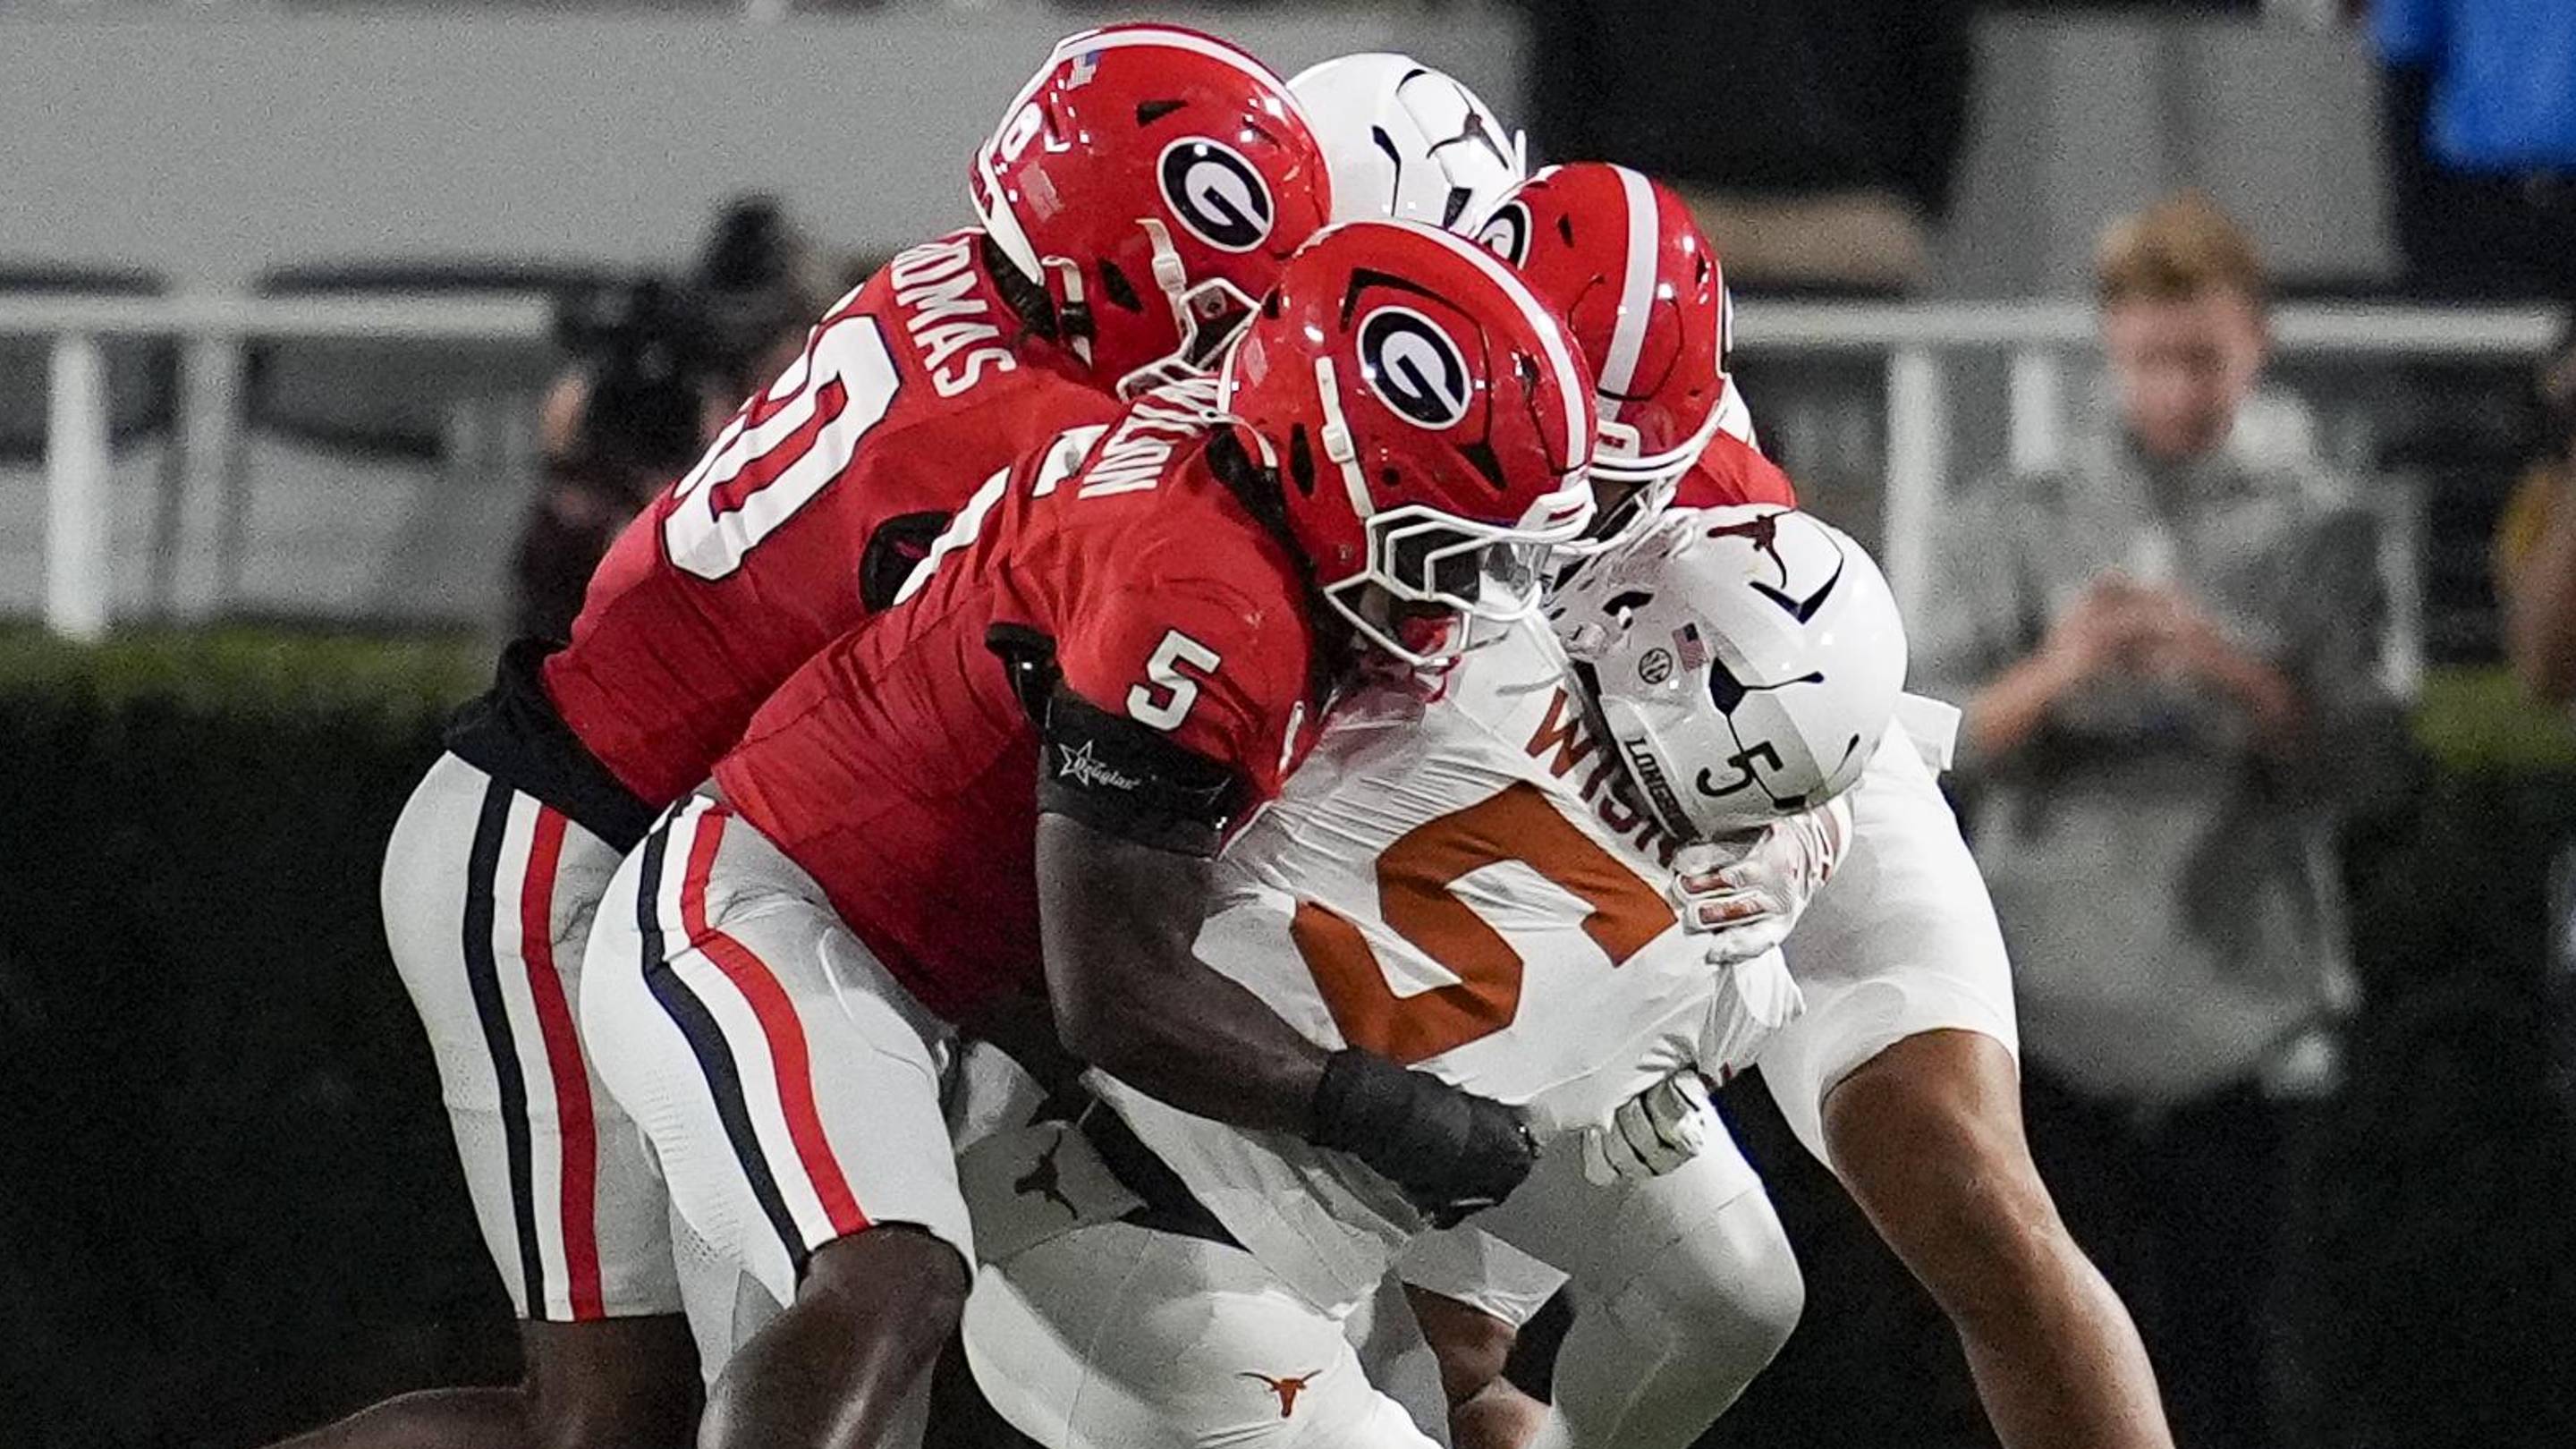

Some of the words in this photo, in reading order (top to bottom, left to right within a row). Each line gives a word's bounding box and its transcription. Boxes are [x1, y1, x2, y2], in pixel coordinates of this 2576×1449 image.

[1162, 141, 1271, 250] G
[891, 236, 1017, 397] OMAS
[1360, 309, 1467, 426] G
[1126, 629, 1222, 732] 5
[1697, 741, 1784, 797] 5
[1291, 779, 1678, 1067] 5
